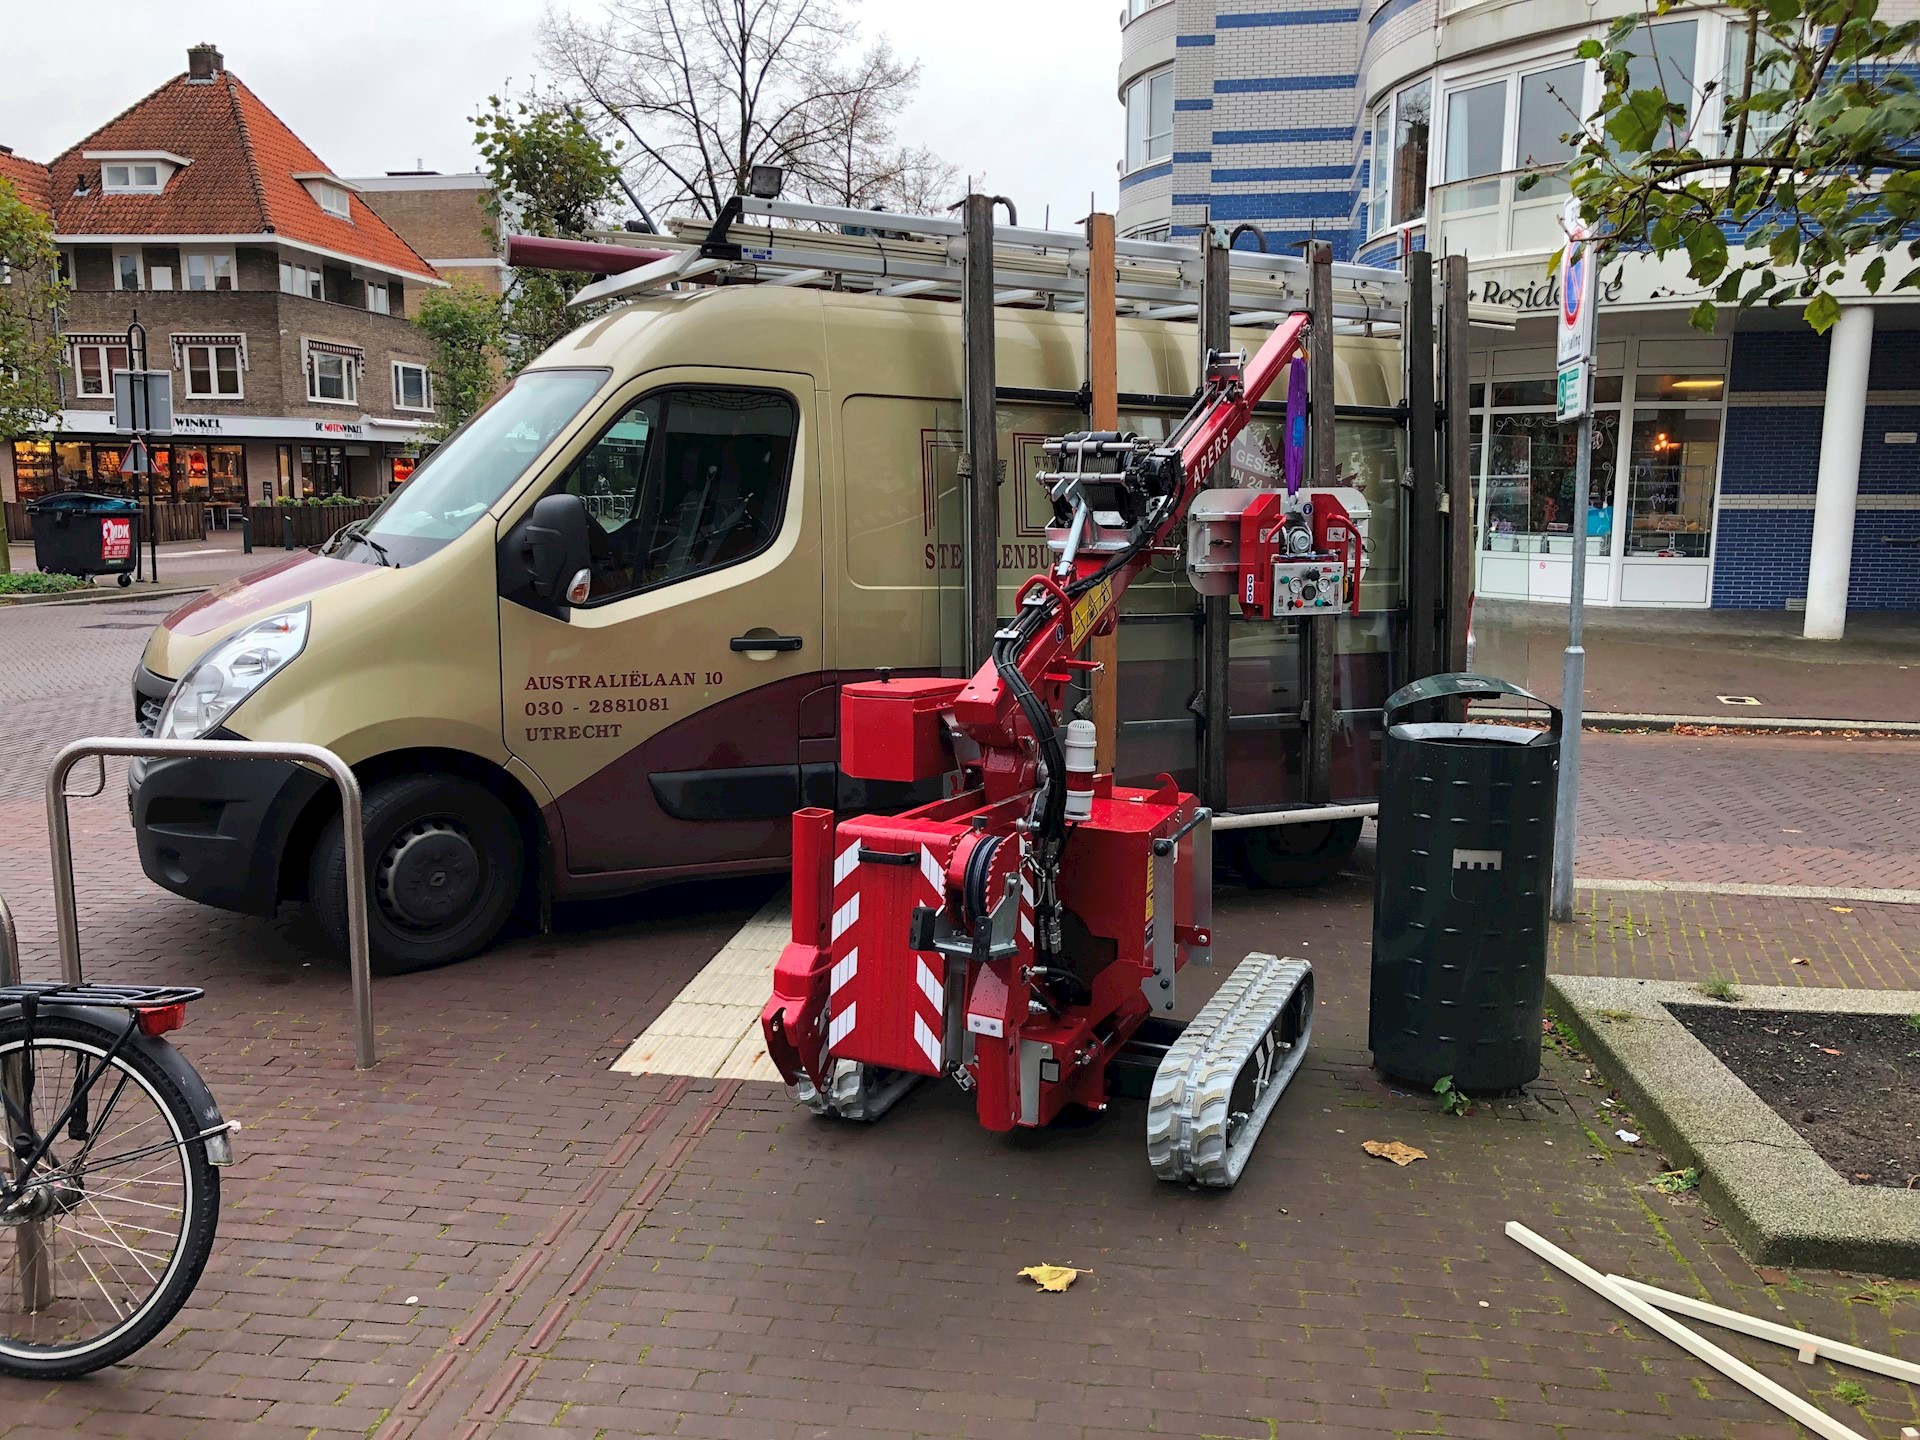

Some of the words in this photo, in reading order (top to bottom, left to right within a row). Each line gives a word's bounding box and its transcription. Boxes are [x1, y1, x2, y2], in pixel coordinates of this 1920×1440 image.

[315, 422, 324, 432] DE
[324, 422, 363, 434] NOTENWINKEL
[1230, 467, 1246, 485] IN
[524, 670, 697, 691] AUSTRALIËLAAN
[704, 671, 724, 686] 10
[524, 701, 564, 717] 030
[588, 697, 670, 714] 2881081
[525, 723, 623, 742] UTRECHT
